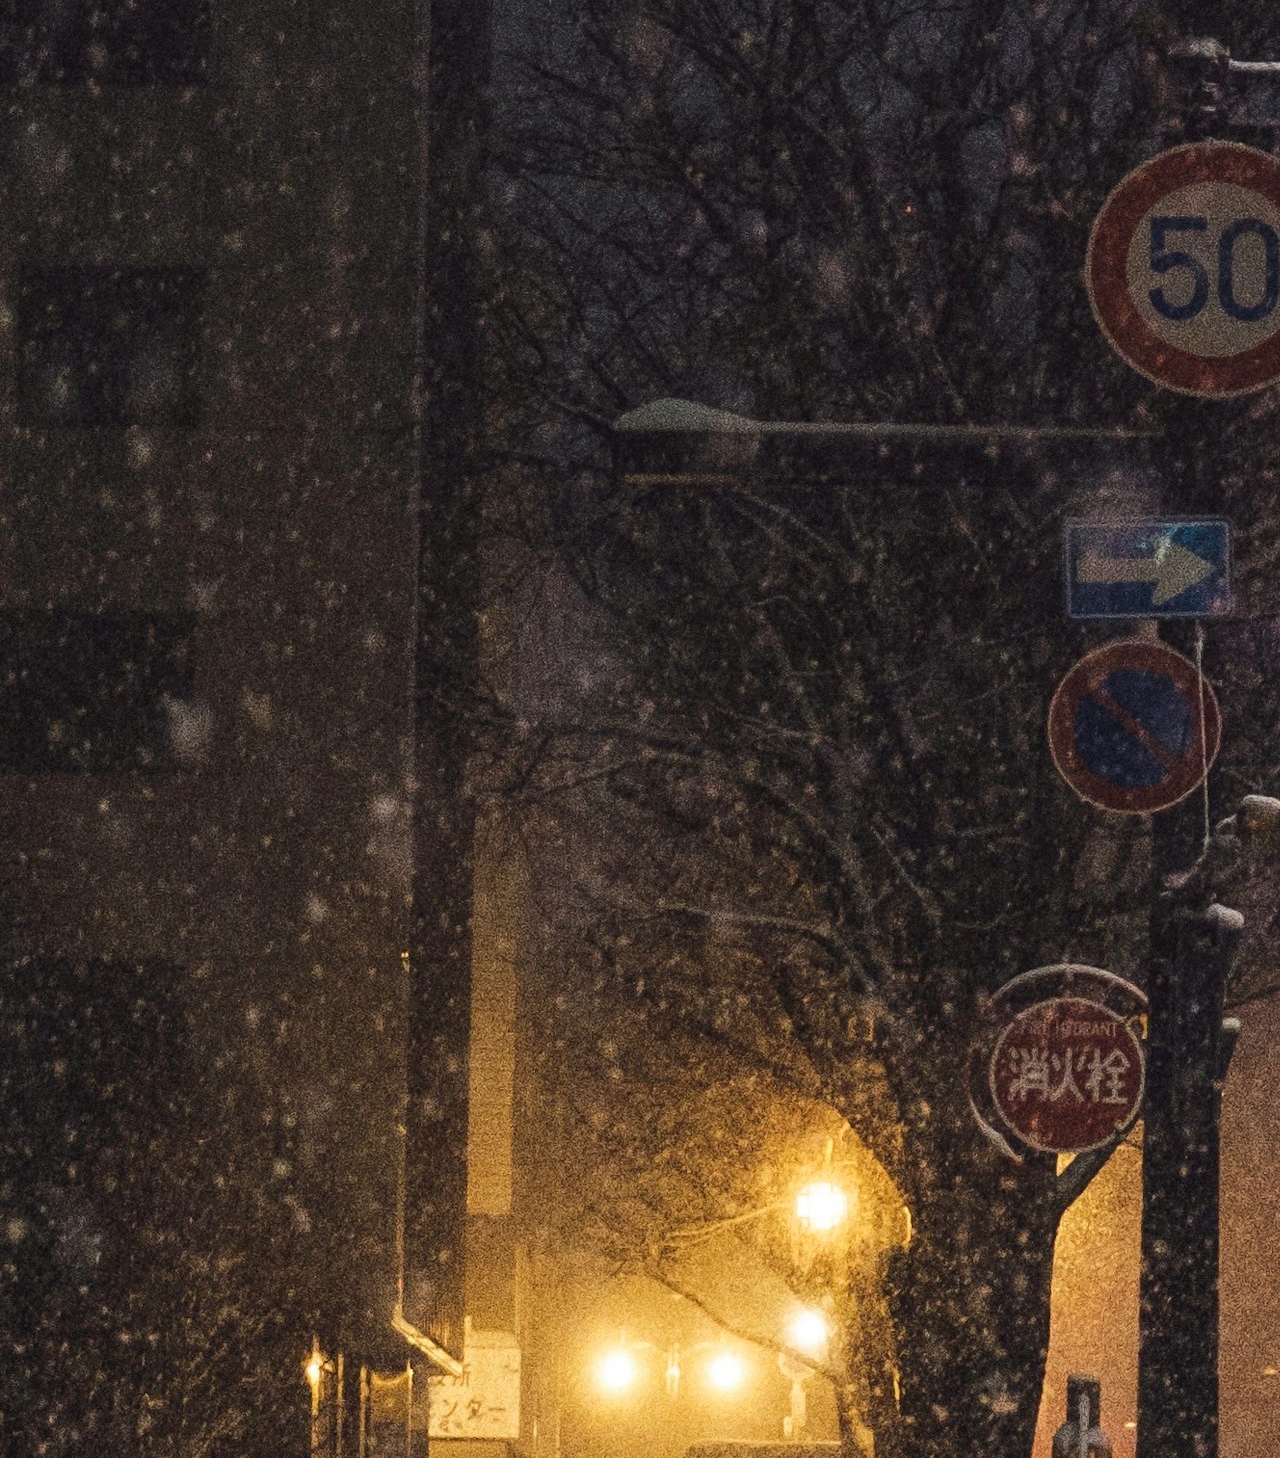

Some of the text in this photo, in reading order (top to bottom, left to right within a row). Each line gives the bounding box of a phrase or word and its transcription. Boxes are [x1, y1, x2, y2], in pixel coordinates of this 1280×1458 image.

[1149, 217, 1280, 322] 50
[1006, 1046, 1132, 1104] 消火栓
